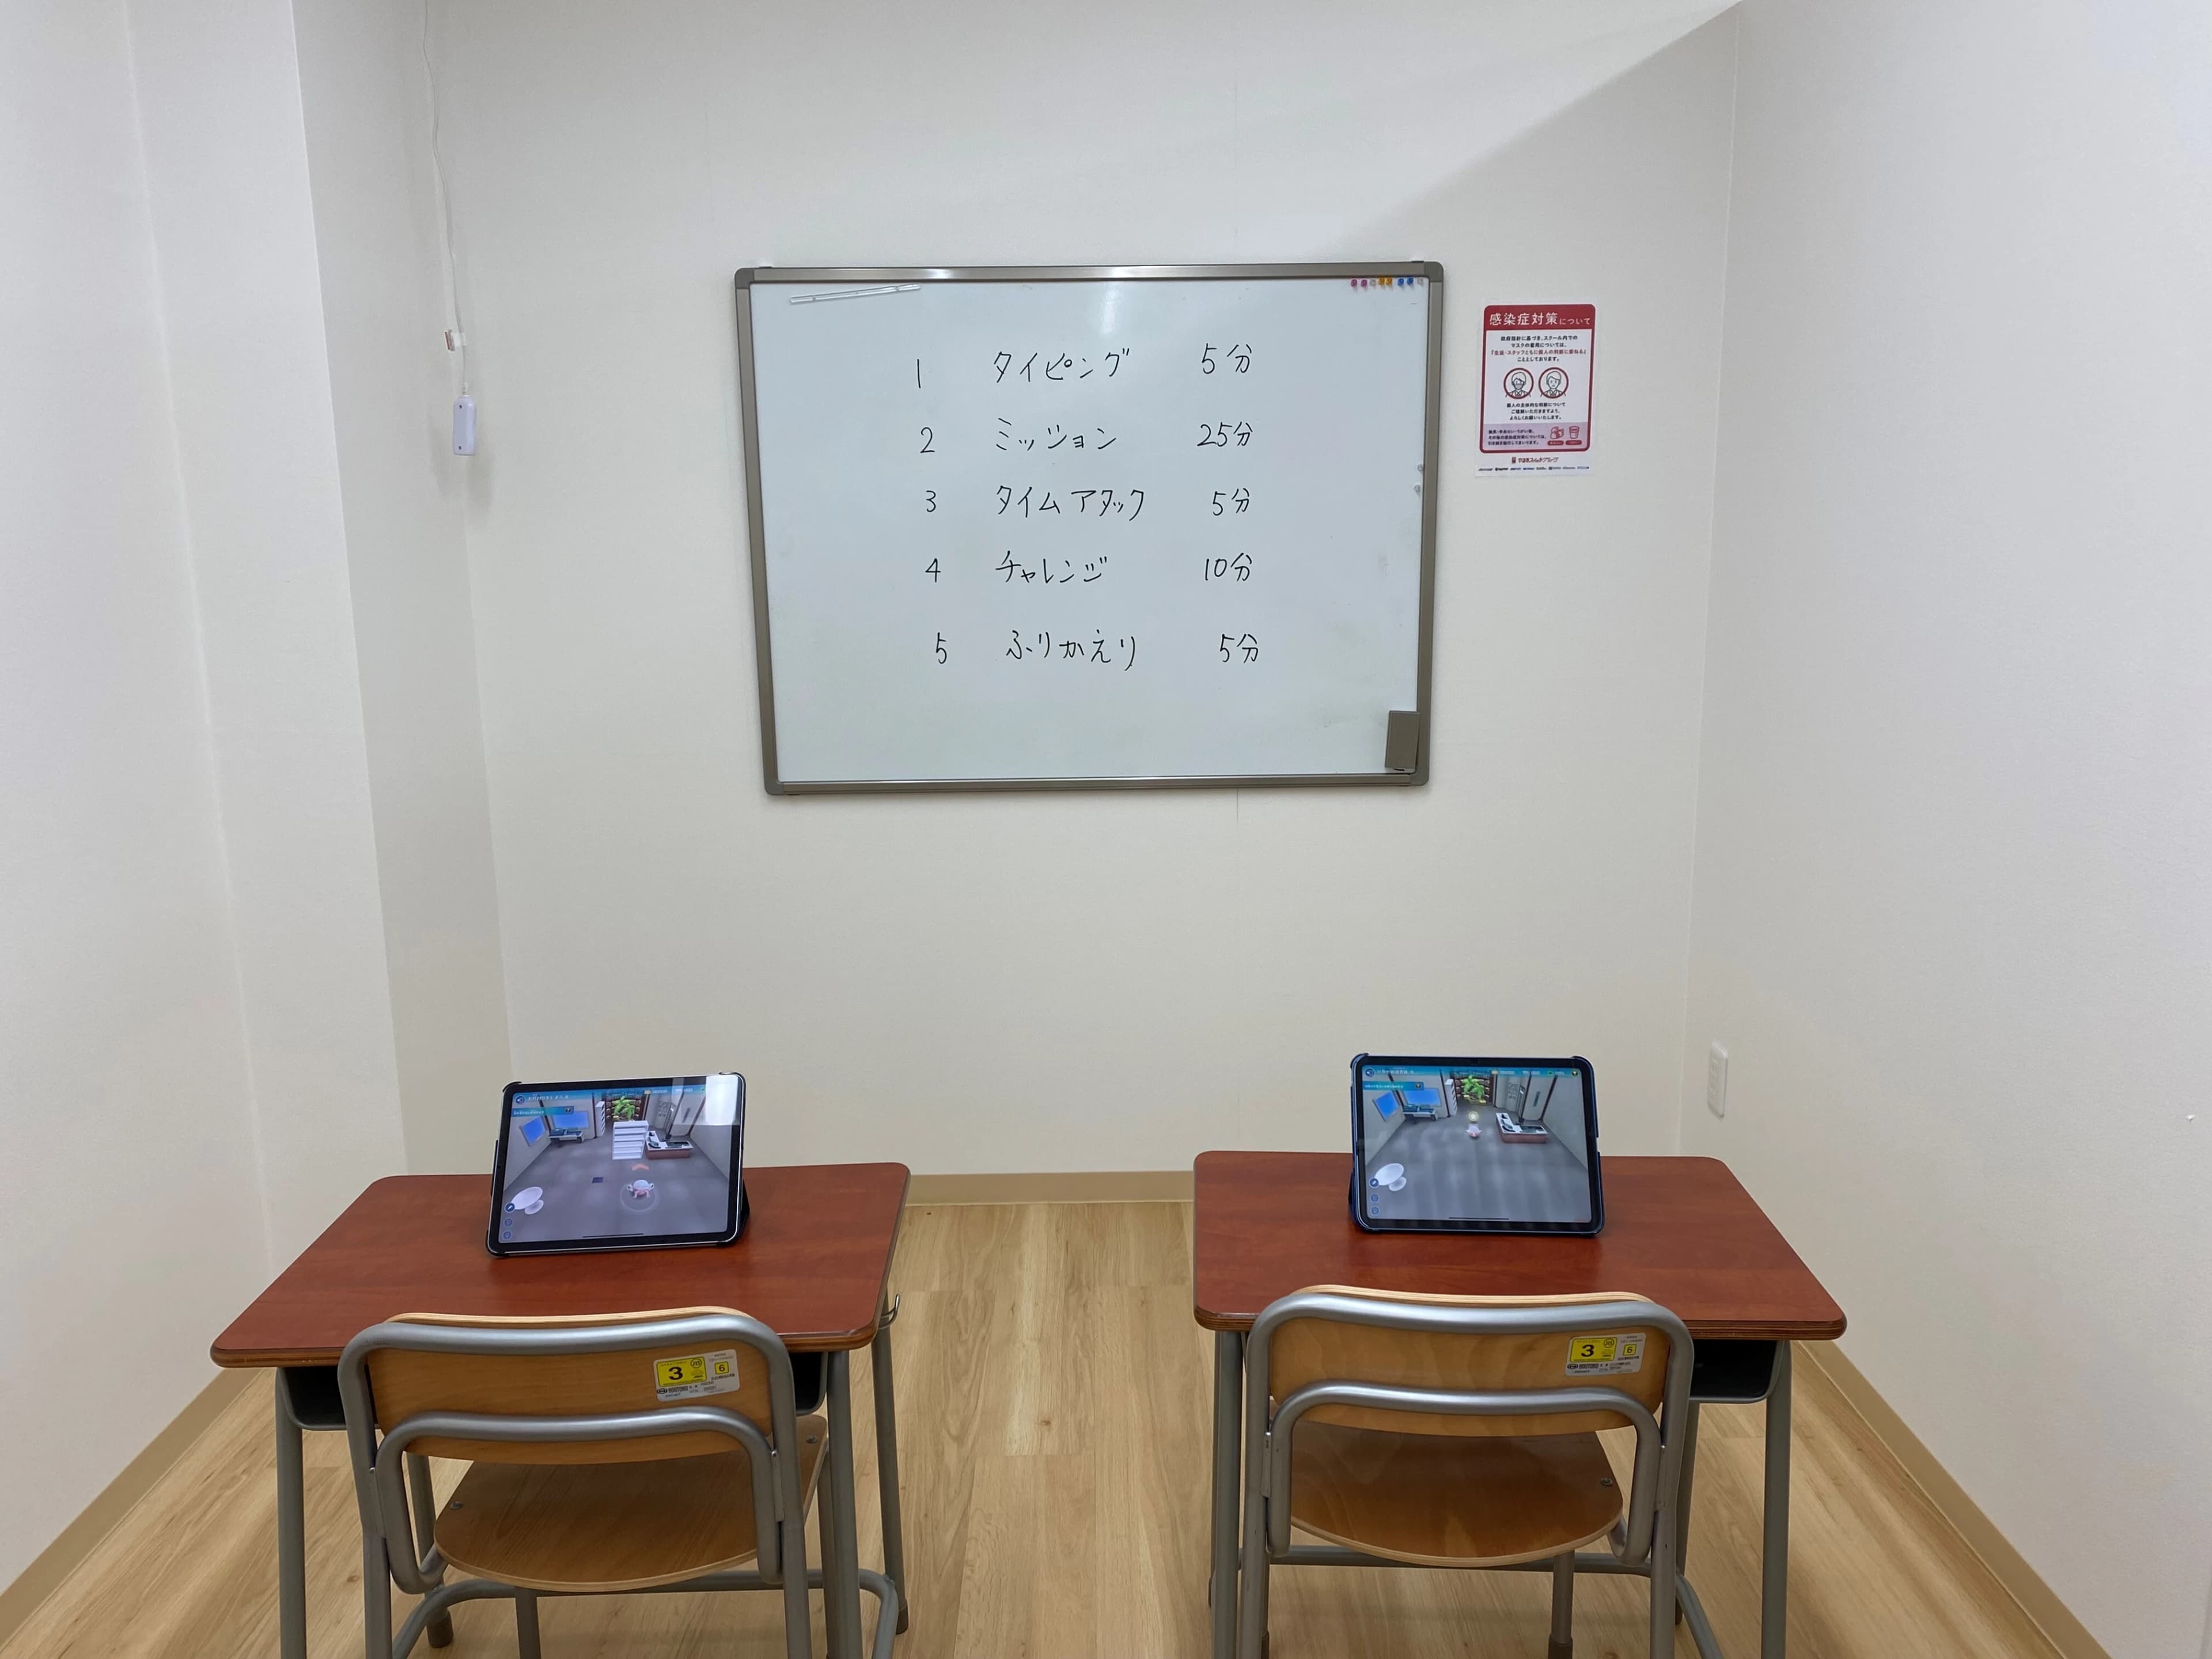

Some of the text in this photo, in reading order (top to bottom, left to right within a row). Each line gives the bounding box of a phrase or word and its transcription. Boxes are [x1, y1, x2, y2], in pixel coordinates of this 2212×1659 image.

[1489, 312, 1591, 326] 感染症対策について
[916, 343, 1252, 389] 1 タイピング 5分
[919, 417, 1253, 454] 2 ミッション 25分
[925, 490, 937, 513] 3
[1212, 487, 1250, 516] 5分
[925, 550, 1252, 584] 4 チャレンジ 10分
[935, 629, 1259, 672] 5 ふりかえり 5分
[1581, 1344, 1594, 1357] 3
[668, 1366, 683, 1380] 3
